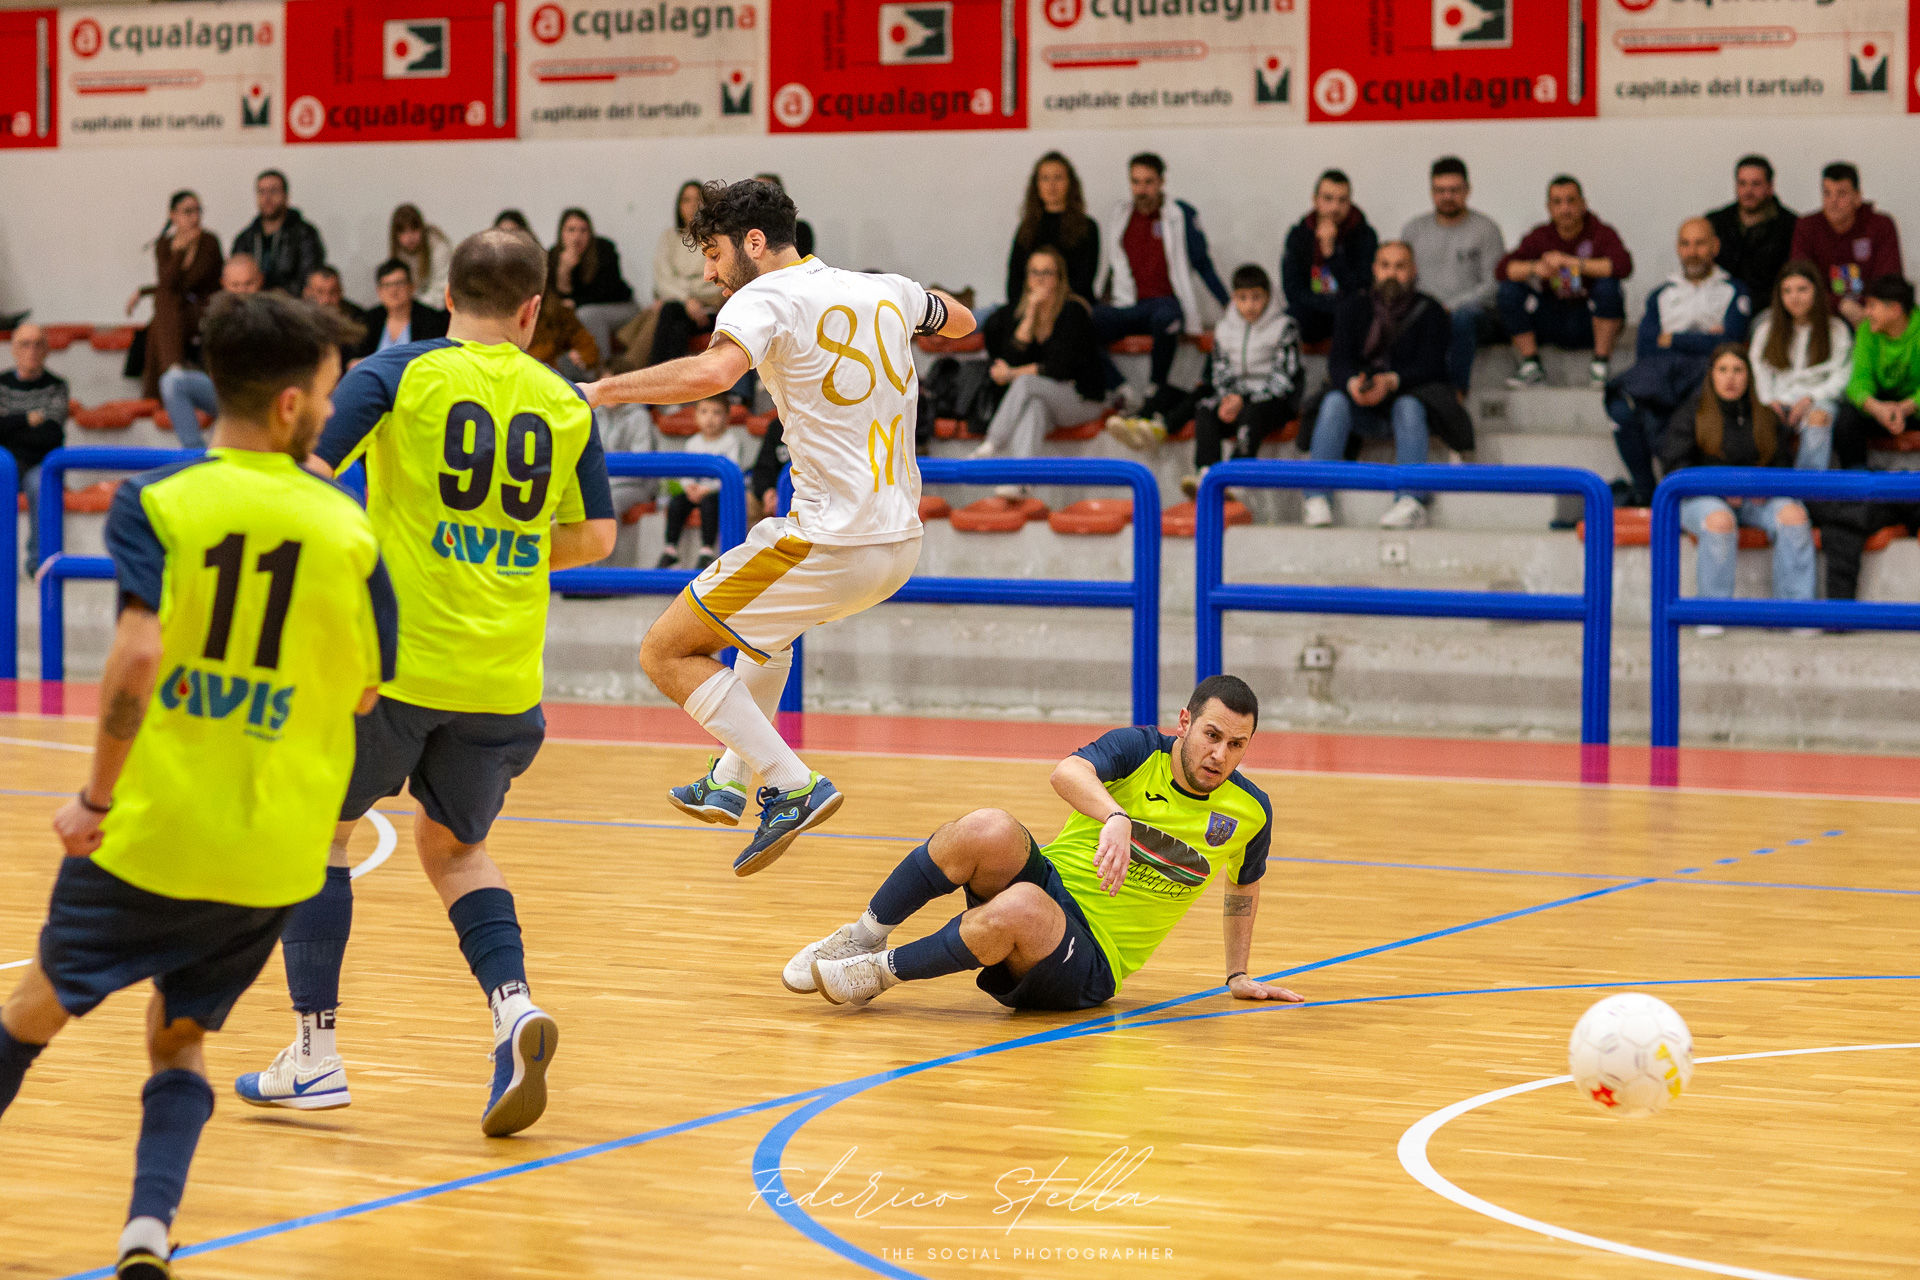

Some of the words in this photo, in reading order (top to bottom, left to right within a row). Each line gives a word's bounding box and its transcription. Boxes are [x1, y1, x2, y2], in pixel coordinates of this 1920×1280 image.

[816, 299, 914, 406] 80
[439, 400, 553, 522] 99
[431, 520, 541, 569] AVIS
[203, 533, 303, 670] 11
[161, 666, 295, 730] AVIS
